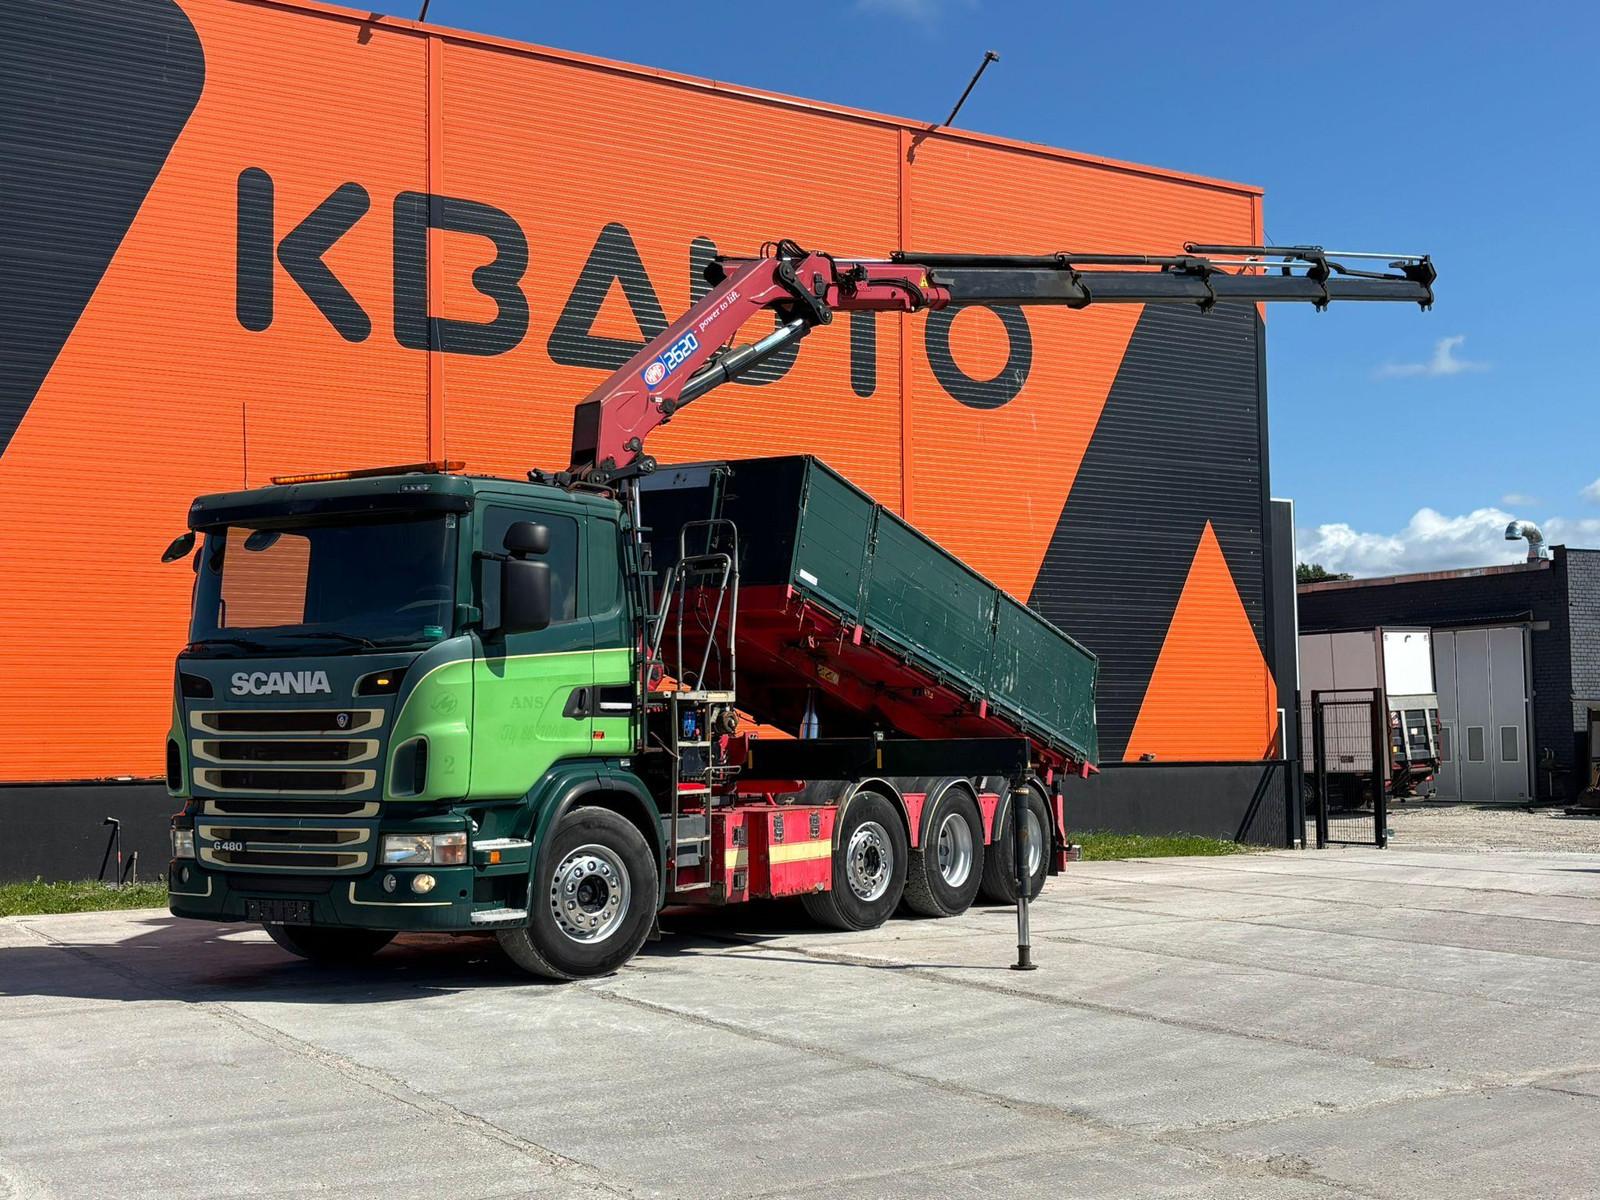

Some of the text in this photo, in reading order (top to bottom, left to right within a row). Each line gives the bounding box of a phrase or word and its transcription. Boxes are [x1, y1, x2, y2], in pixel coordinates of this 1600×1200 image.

[699, 308, 721, 332] power
[720, 303, 728, 312] to
[664, 333, 699, 370] 2620
[230, 670, 332, 696] SCANIA
[213, 841, 243, 852] G 480
